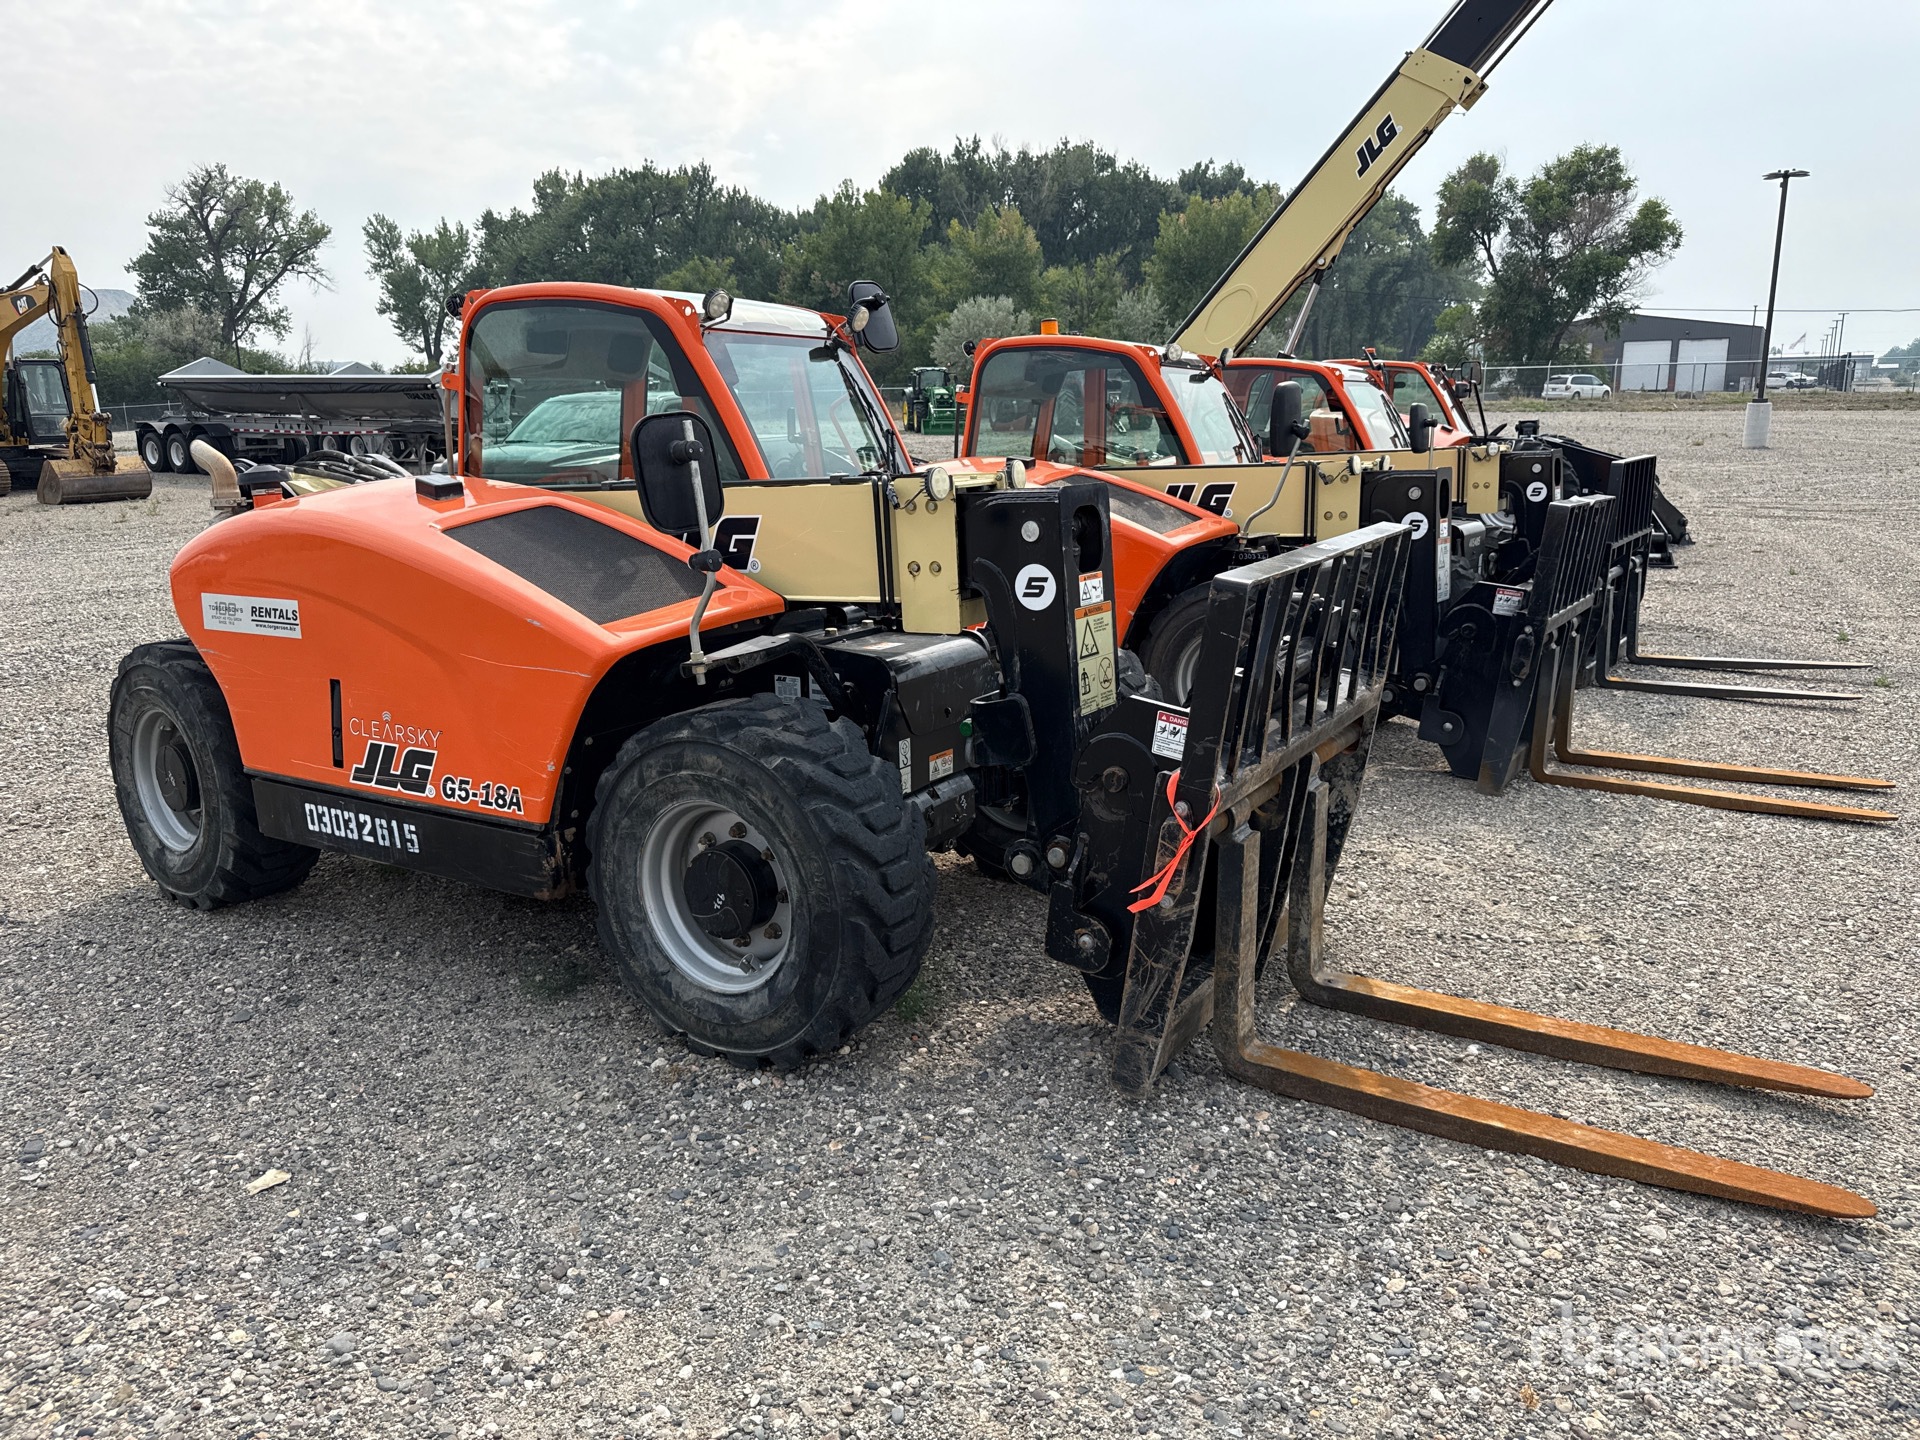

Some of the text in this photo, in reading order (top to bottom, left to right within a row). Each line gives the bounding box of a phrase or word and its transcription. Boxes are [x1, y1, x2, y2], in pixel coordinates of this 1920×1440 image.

[1356, 112, 1399, 180] JLG
[18, 296, 32, 317] CAT
[251, 605, 298, 621] RENTALS
[350, 717, 441, 748] CLEARSKY
[350, 740, 438, 797] JLG
[441, 775, 524, 815] G5-18A
[304, 802, 420, 854] 03032615
